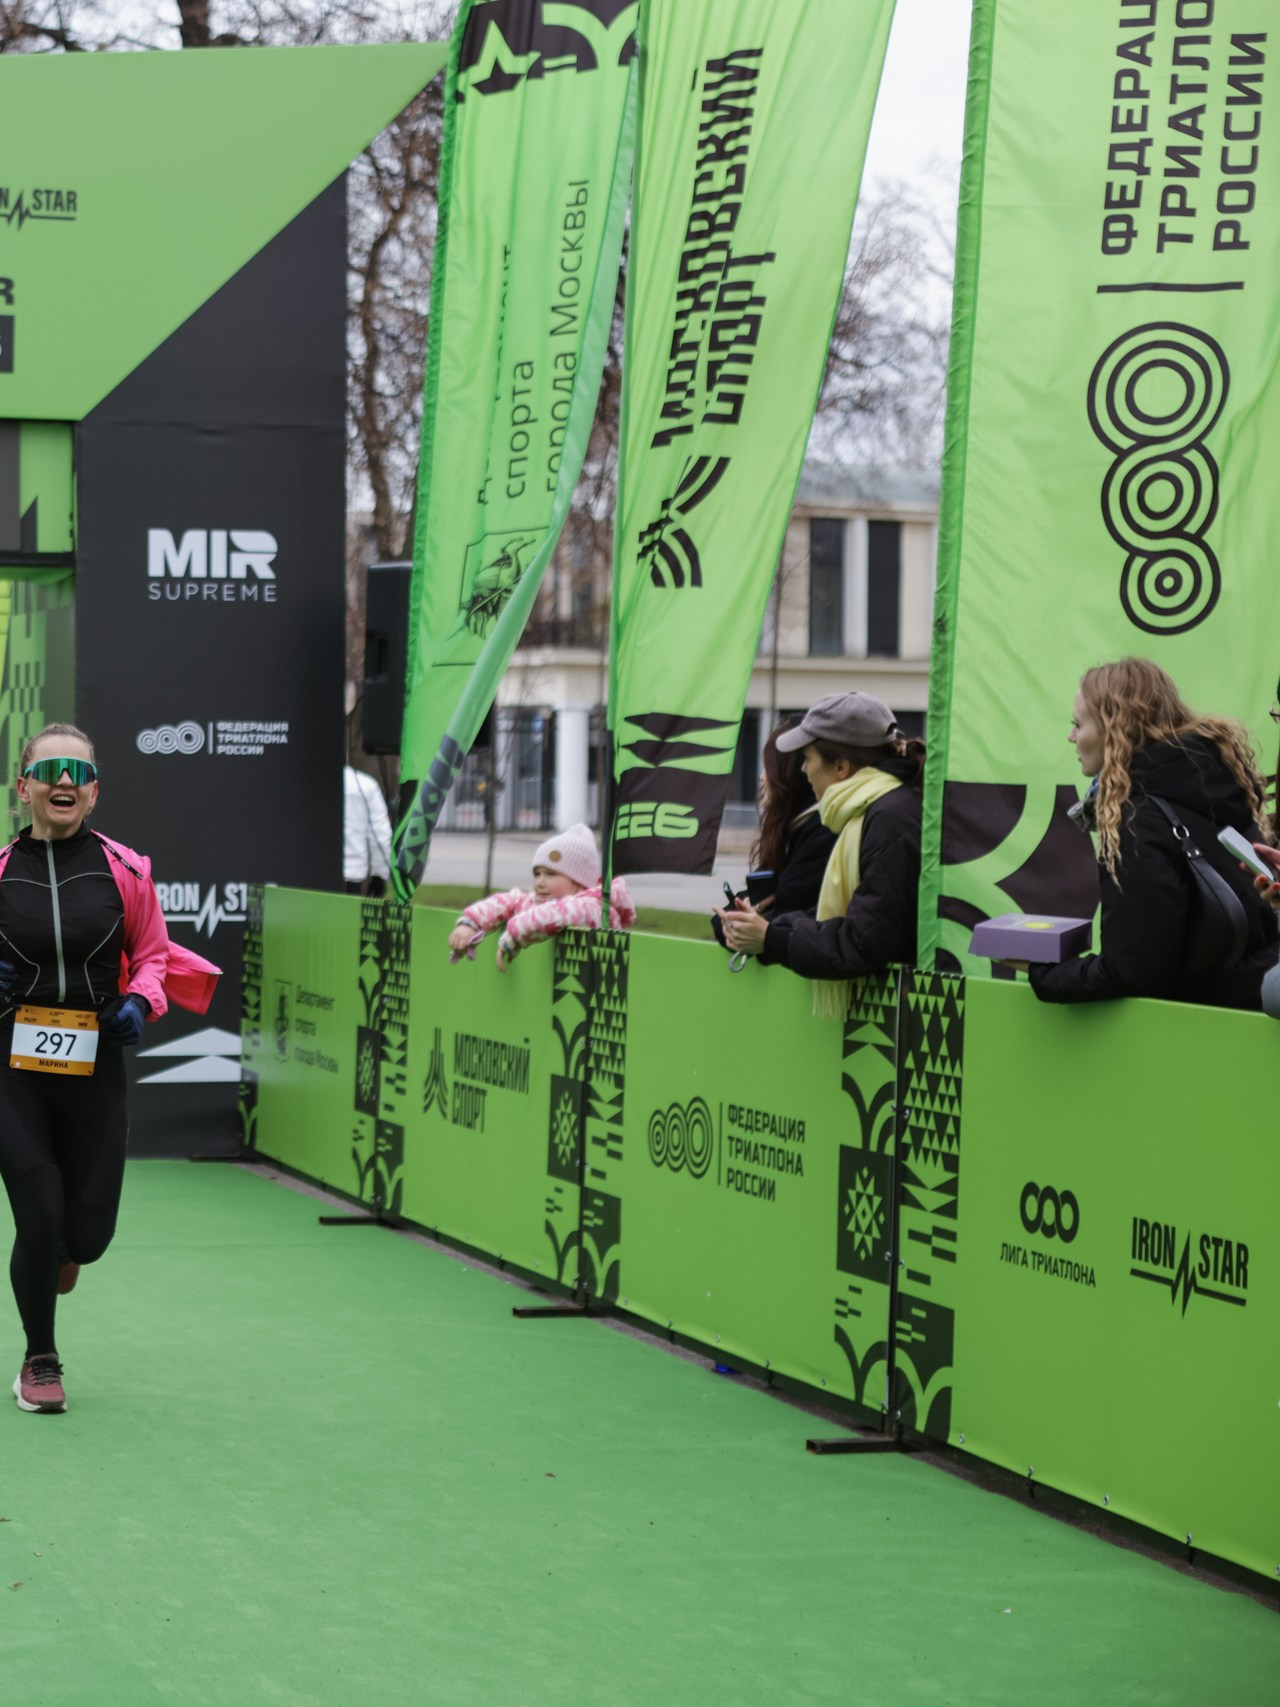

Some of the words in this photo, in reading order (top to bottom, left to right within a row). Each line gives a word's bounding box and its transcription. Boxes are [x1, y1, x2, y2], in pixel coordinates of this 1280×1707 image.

[1212, 32, 1268, 251] РОССИИ
[32, 187, 78, 213] STAR
[550, 179, 590, 337] Москвы
[506, 360, 539, 499] спорта
[147, 528, 278, 579] MIR
[148, 582, 277, 602] SUPREME
[216, 721, 289, 733] ФЕДЕРАЦИЯ
[216, 733, 289, 744] ТРИАТЛОНА
[216, 744, 265, 755] РОССИИ
[155, 882, 200, 912] RON
[34, 1031, 77, 1056] 297
[454, 1031, 531, 1095] МОСКОВСКИЙ
[39, 1059, 69, 1069] МАРИНА
[452, 1081, 488, 1133] СПОРТ
[728, 1104, 806, 1143] ФЕДЕРАЦИЯ
[727, 1135, 804, 1177] ТРИАТЛОНА
[726, 1167, 776, 1203] РОССИИ
[1000, 1242, 1028, 1268] ЛИГА
[1031, 1251, 1096, 1288] ТРИАТЛОНА
[1131, 1216, 1176, 1270] IRON
[1198, 1233, 1249, 1290] STAR
